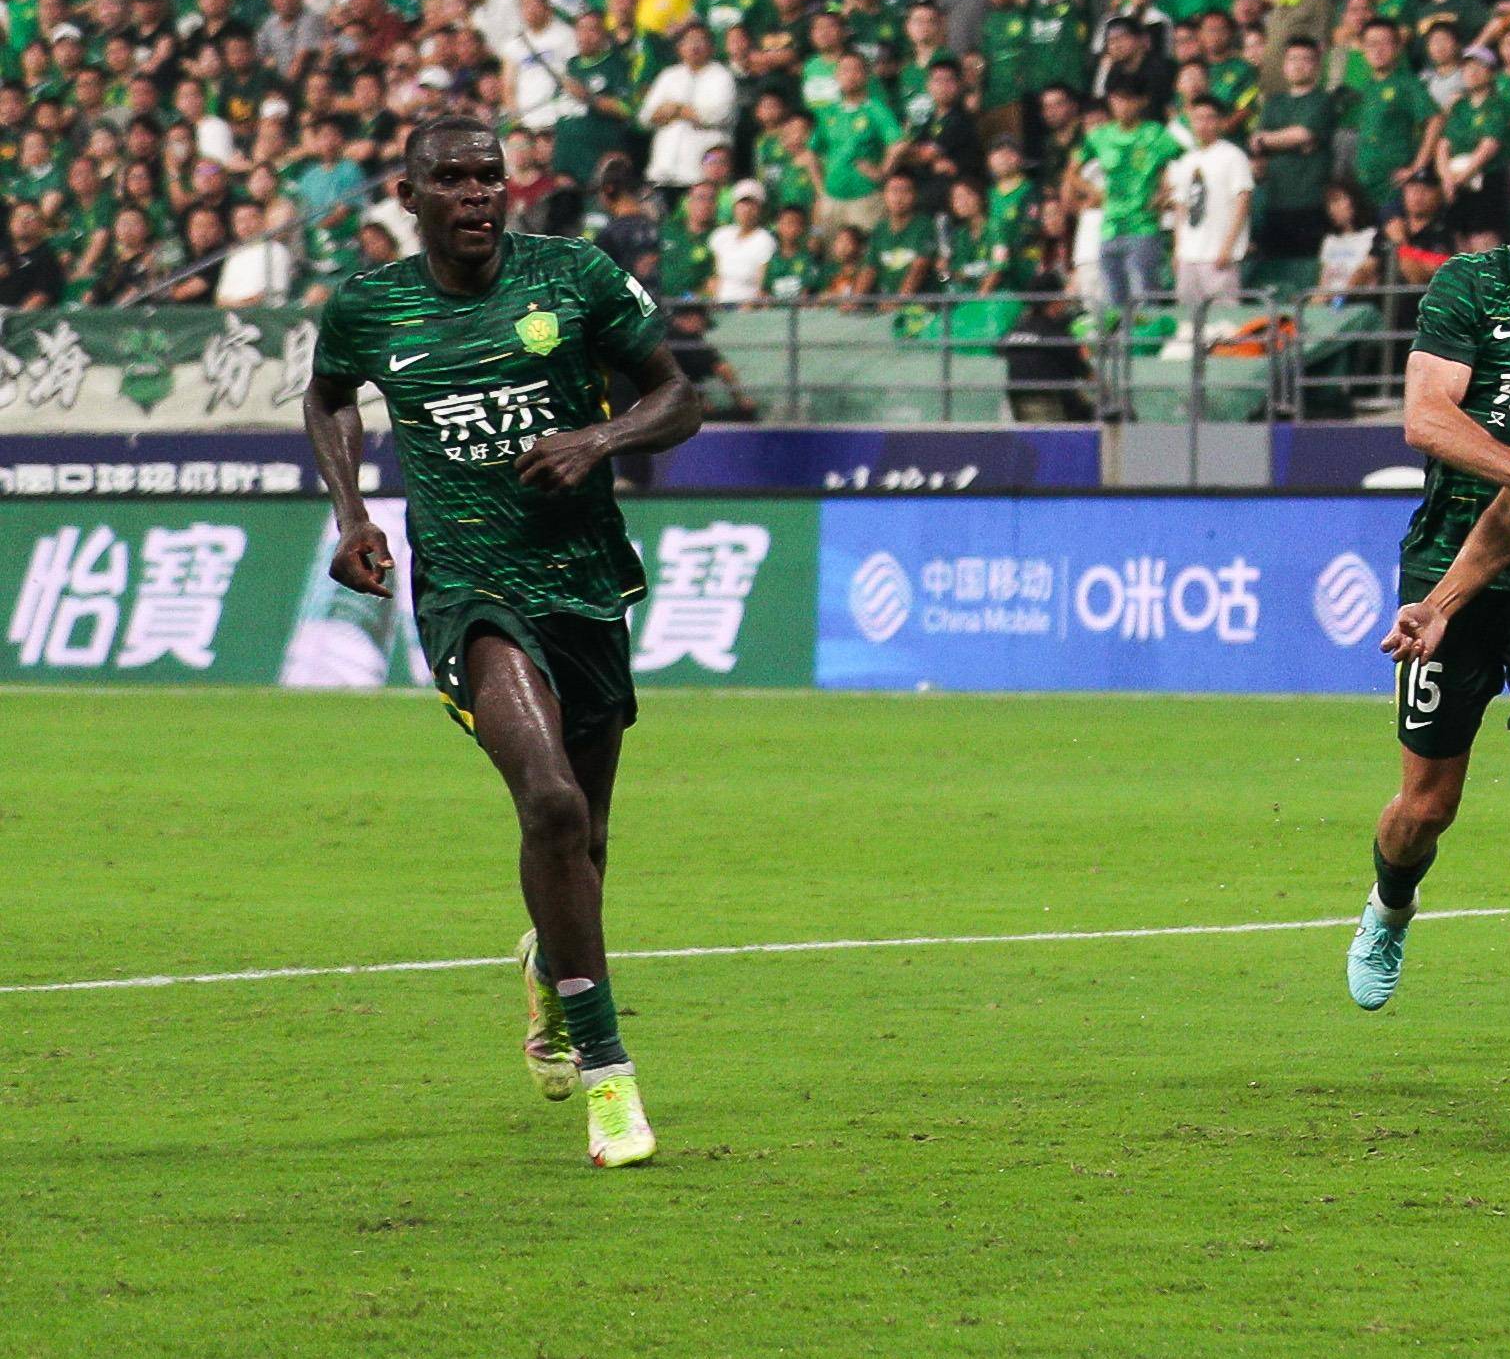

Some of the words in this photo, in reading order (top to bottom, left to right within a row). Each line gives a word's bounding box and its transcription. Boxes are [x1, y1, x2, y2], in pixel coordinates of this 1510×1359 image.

[423, 379, 555, 442] 京东
[631, 521, 772, 673] 寶
[922, 557, 1053, 602] 中国移动
[1407, 657, 1444, 713] 15
